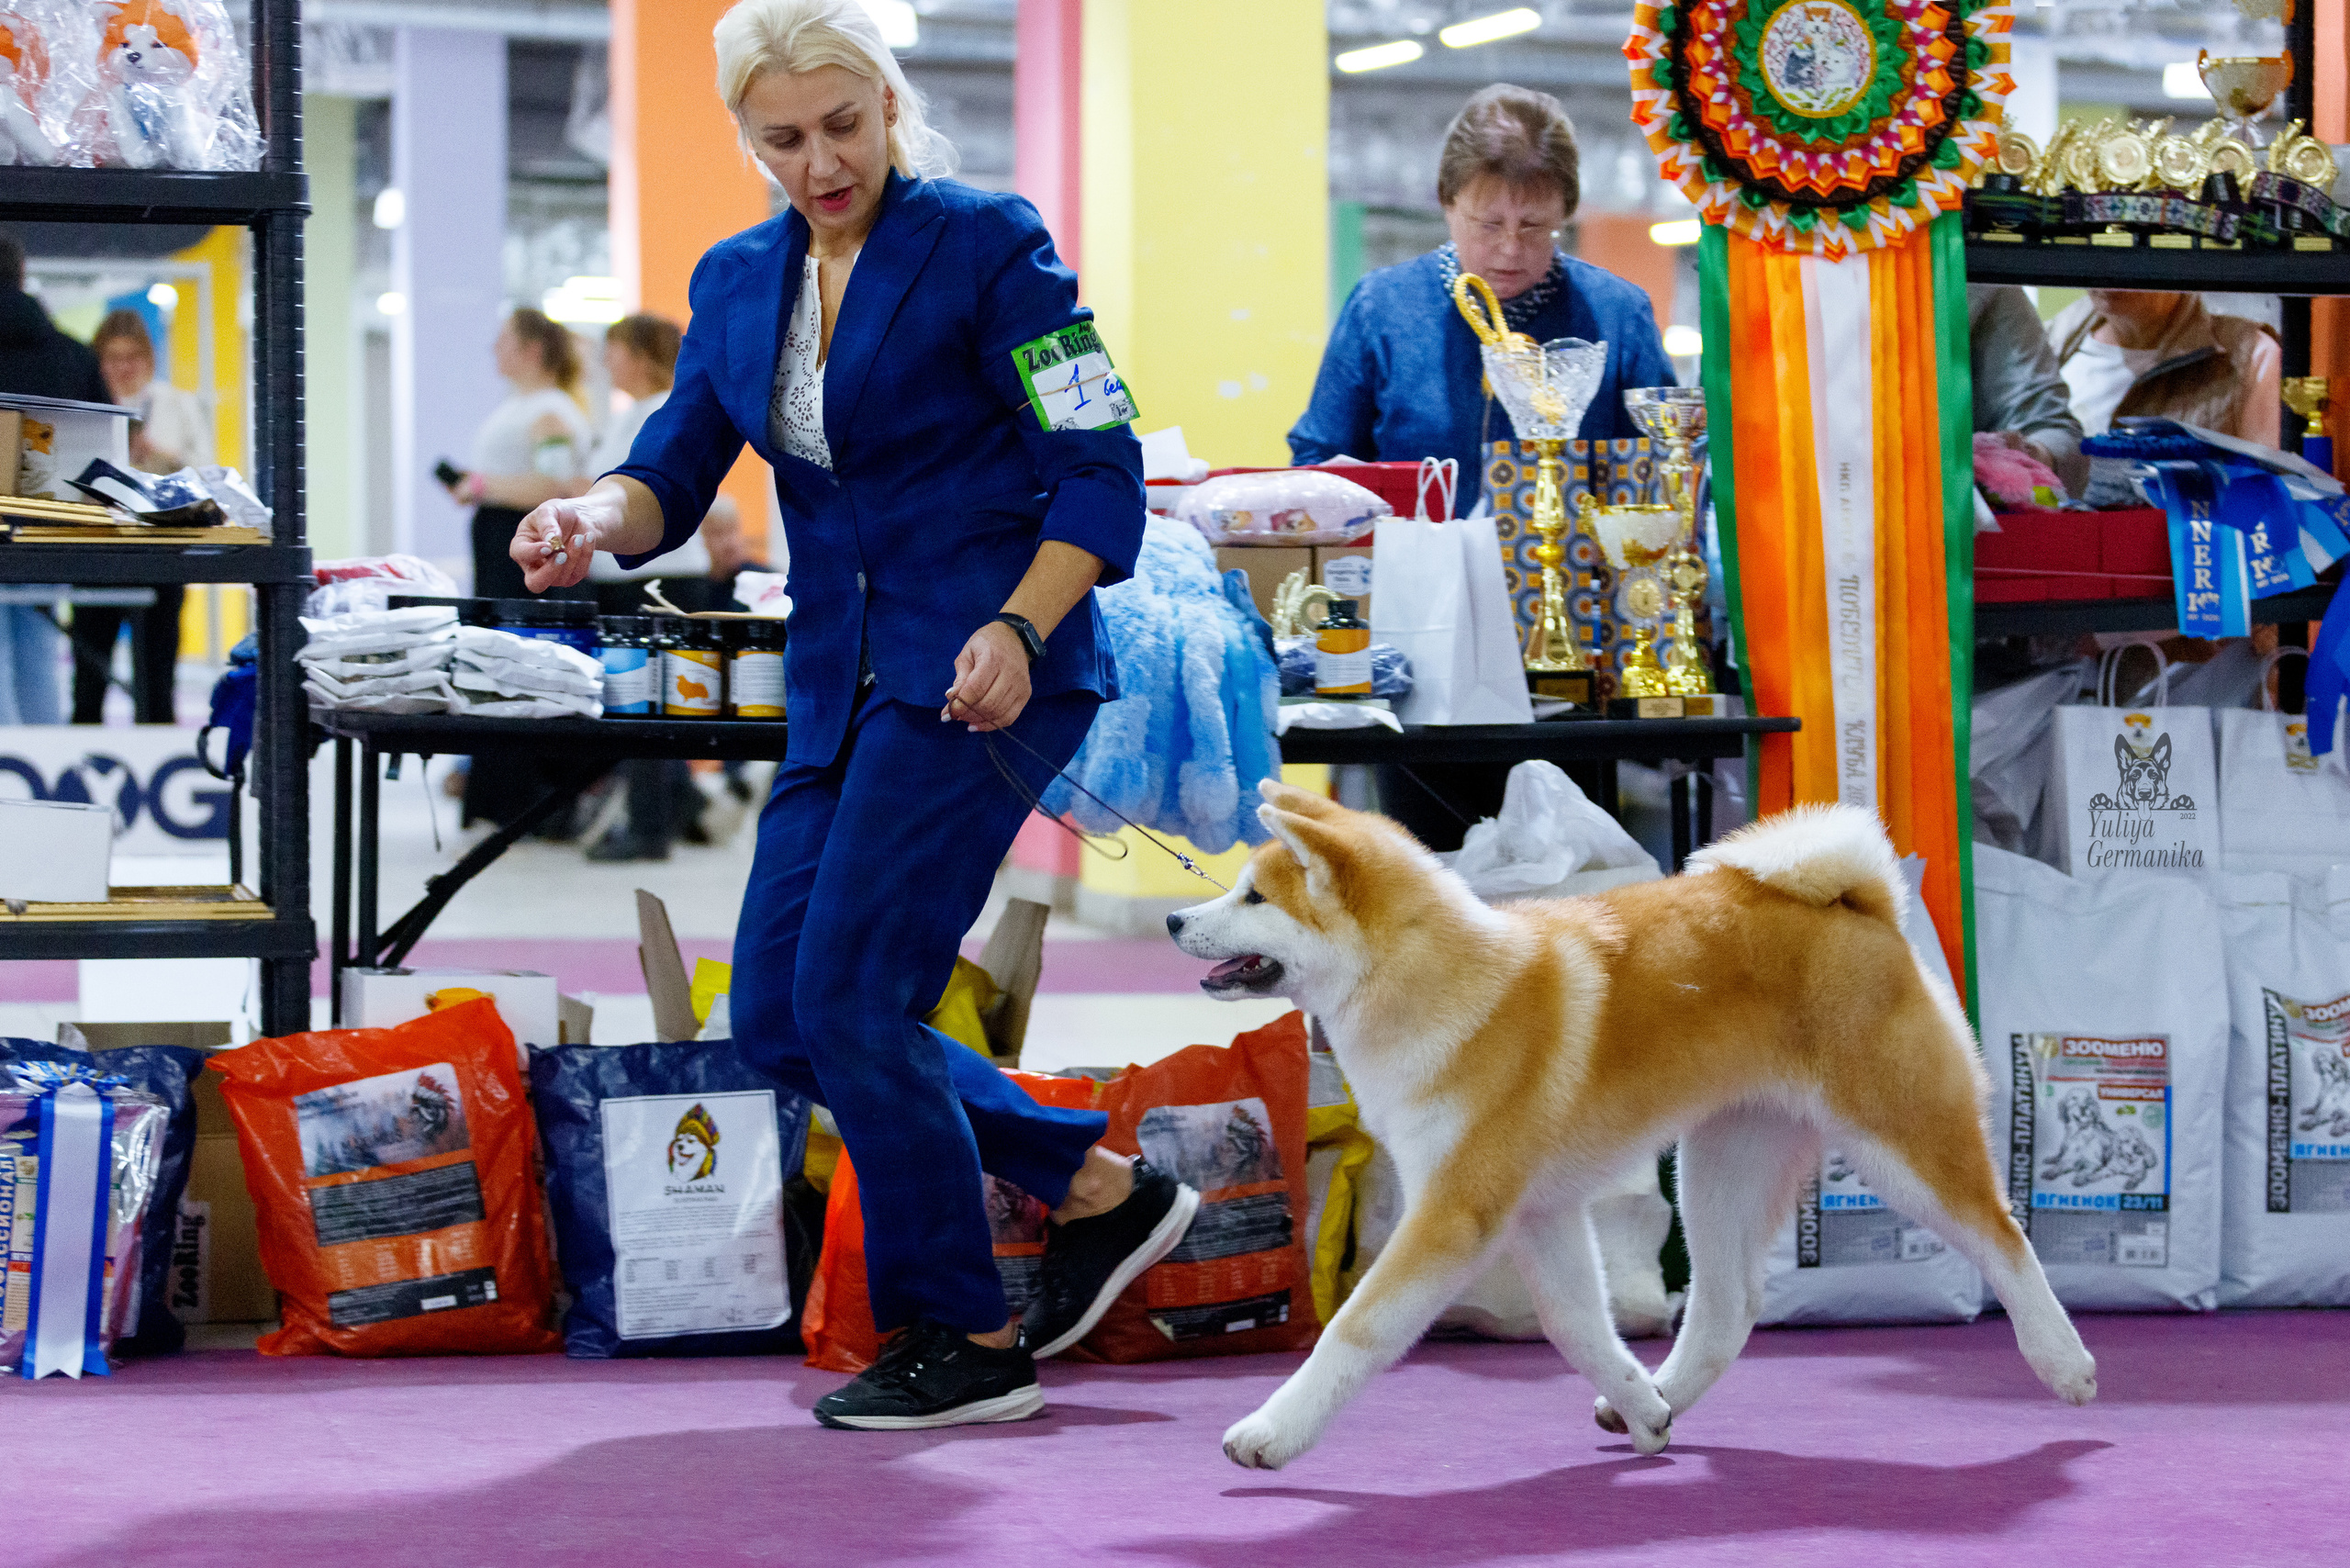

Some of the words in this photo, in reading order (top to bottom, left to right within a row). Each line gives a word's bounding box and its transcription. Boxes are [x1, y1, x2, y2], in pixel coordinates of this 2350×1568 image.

[1023, 329, 1102, 373] ZooRing
[2065, 1039, 2164, 1057] ЗООМЕНЮ
[2036, 1193, 2117, 1209] ЯГНЕНОК
